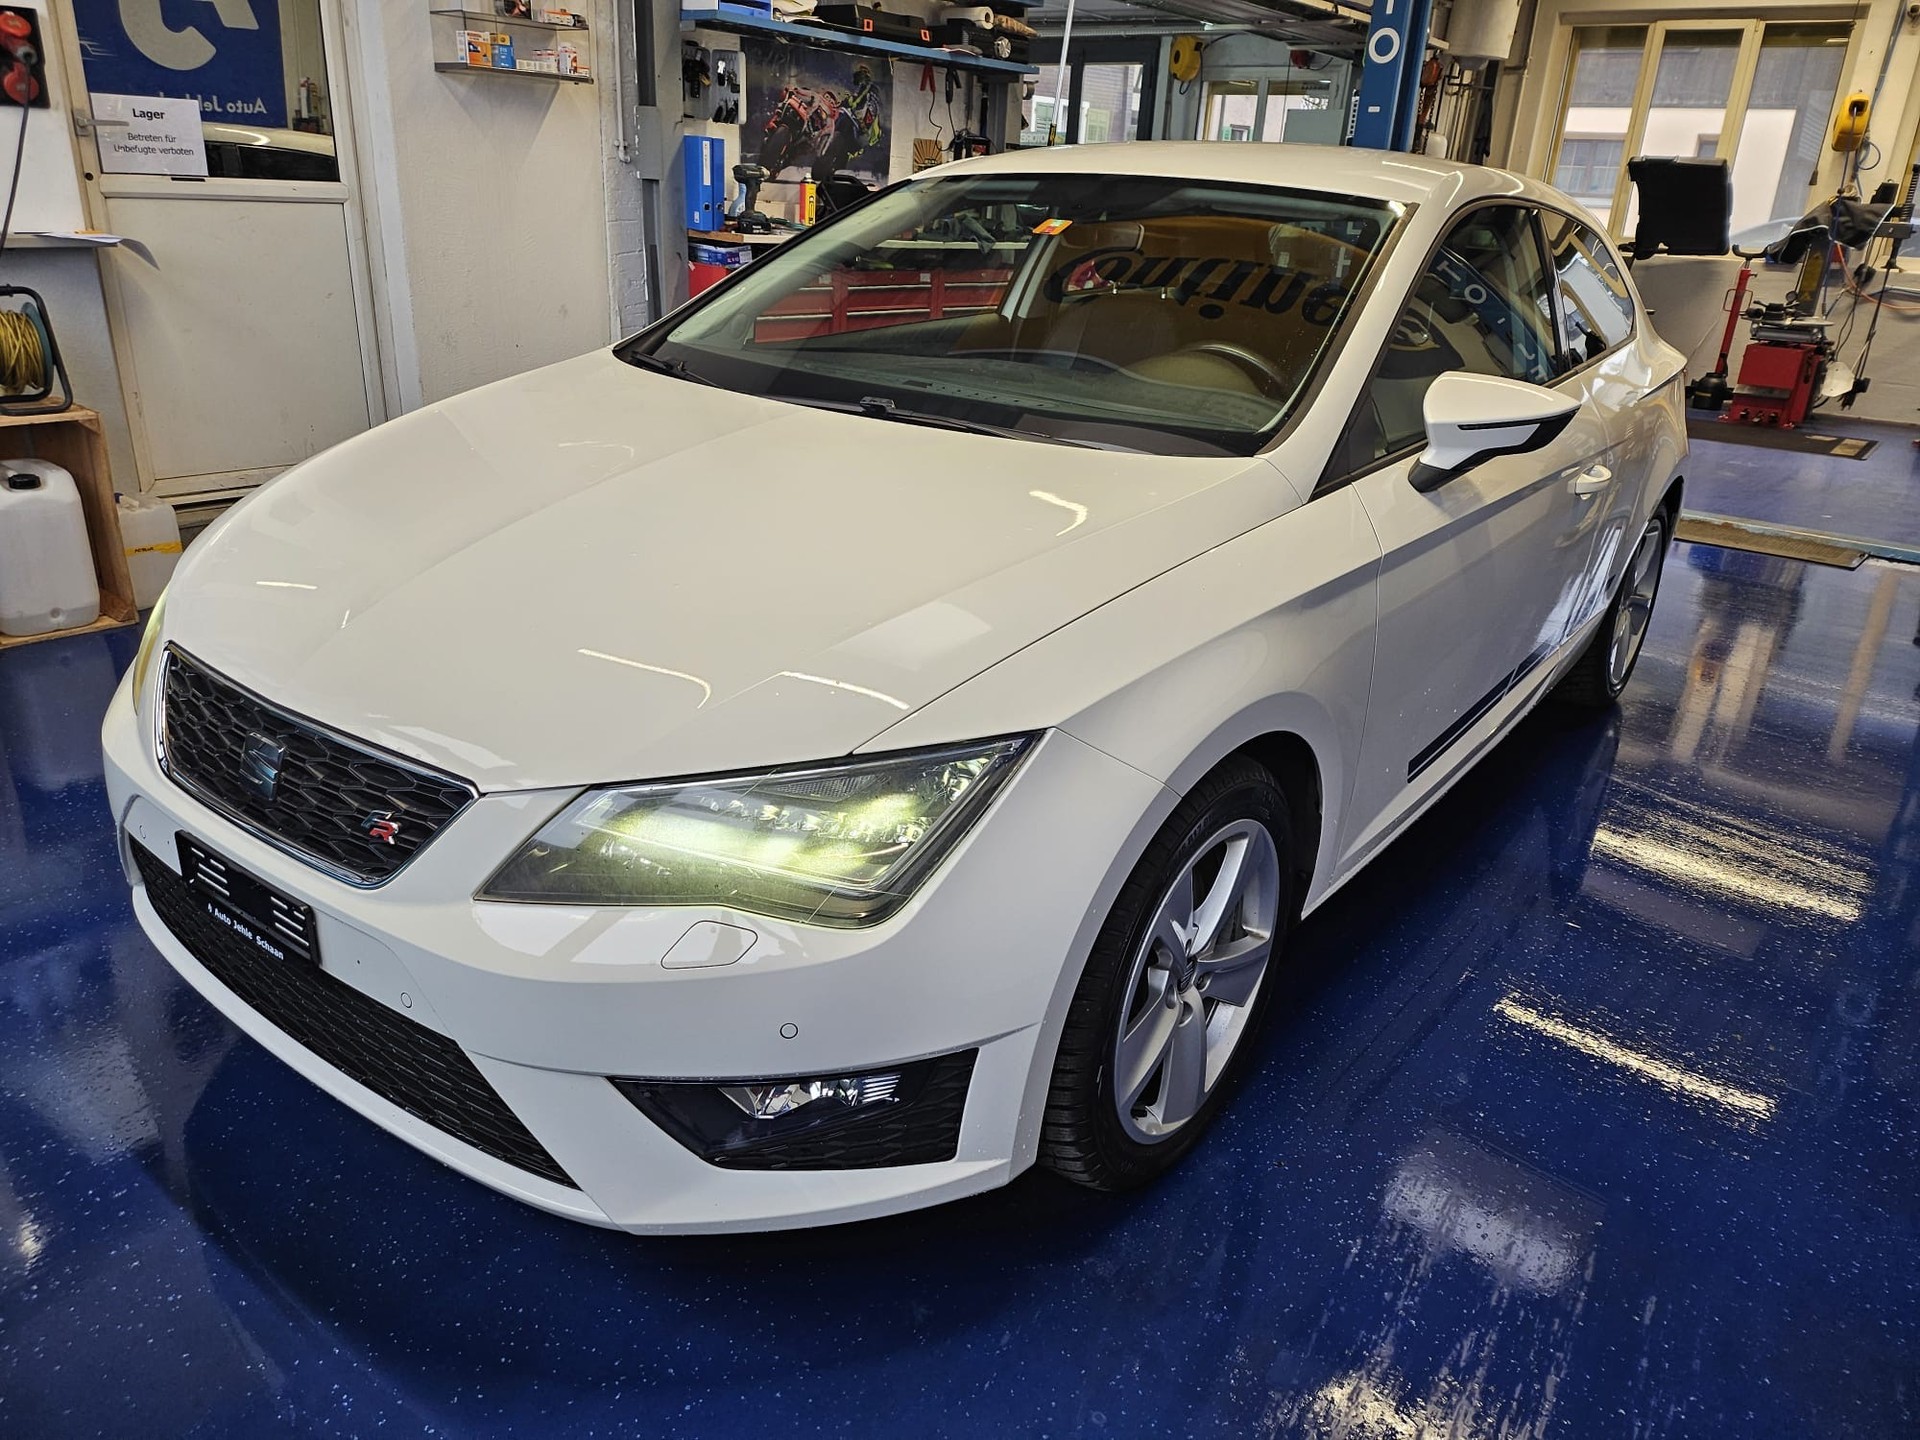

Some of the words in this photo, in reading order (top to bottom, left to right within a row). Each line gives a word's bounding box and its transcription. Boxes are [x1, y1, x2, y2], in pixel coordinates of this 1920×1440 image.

[132, 107, 165, 121] Lager
[127, 132, 163, 142] Betreten
[165, 133, 177, 143] für
[113, 143, 157, 155] Unbefugte
[158, 146, 194, 156] verboten
[214, 907, 232, 926] Auto
[233, 919, 253, 940] Jehle
[256, 935, 284, 960] Schaan
